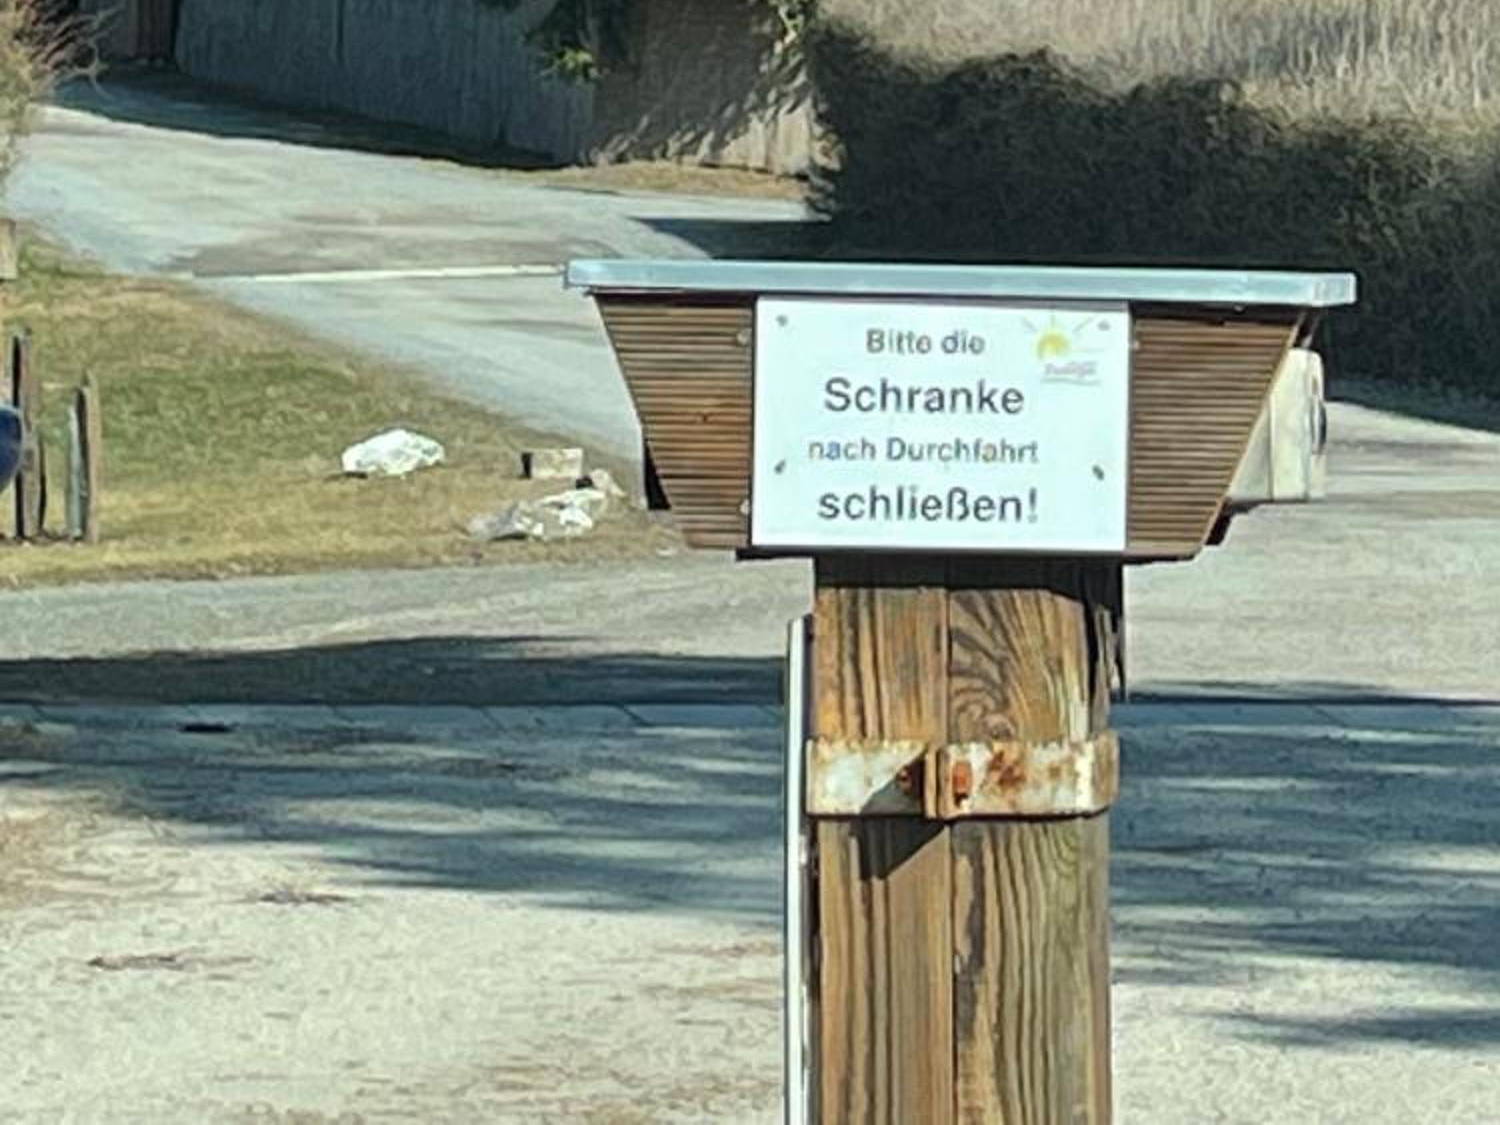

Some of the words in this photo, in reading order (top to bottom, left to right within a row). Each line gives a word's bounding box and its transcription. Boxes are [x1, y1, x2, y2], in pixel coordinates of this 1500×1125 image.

[865, 328, 932, 355] Bitte
[940, 330, 986, 356] die
[823, 376, 1025, 416] Schranke
[807, 437, 877, 462] nach
[885, 436, 1039, 464] Durchfahrt
[817, 484, 1039, 524] schließen!
